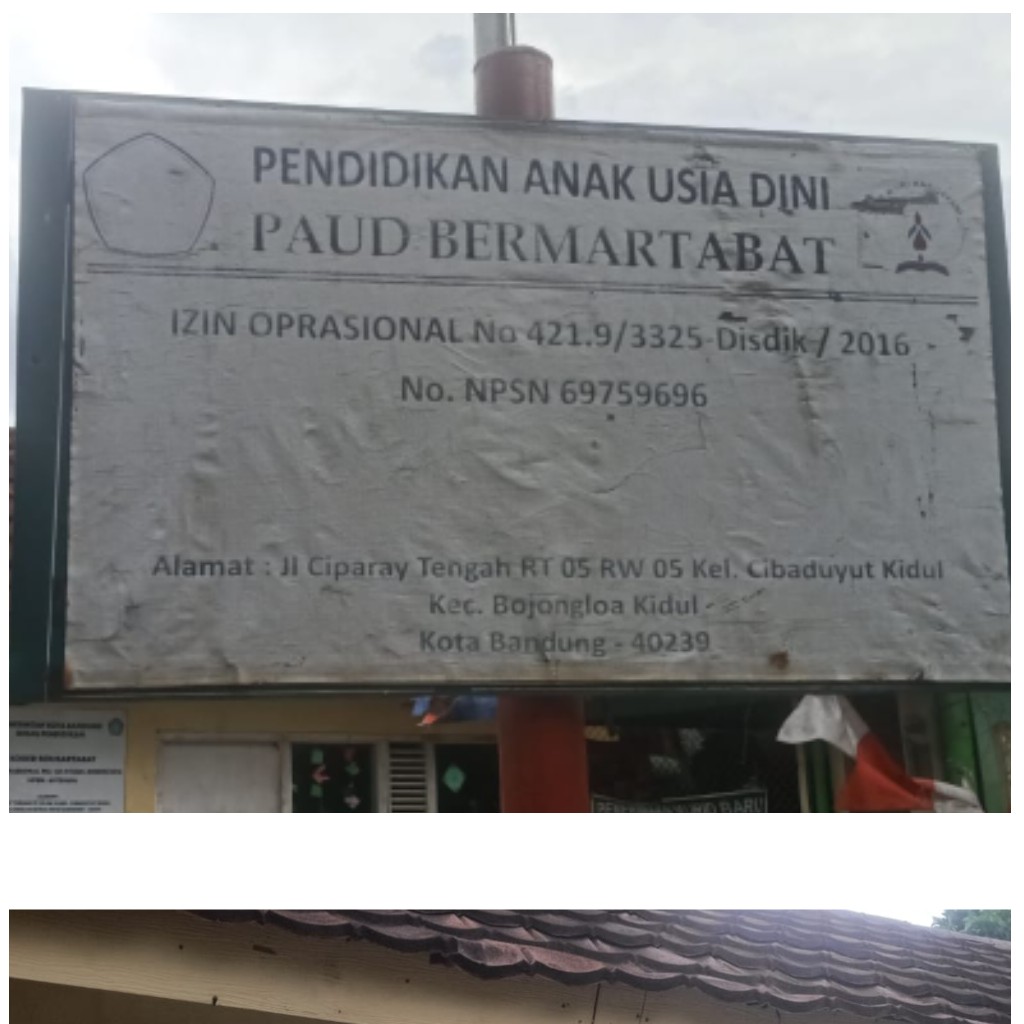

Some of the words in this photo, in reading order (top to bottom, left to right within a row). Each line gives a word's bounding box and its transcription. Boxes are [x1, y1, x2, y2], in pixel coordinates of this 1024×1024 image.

[253, 146, 510, 194] PENDIDIKAN
[521, 157, 635, 203] ANAK
[647, 164, 742, 208] USIA
[750, 173, 830, 211] DINI
[252, 211, 411, 259] PAUD
[431, 217, 835, 276] BERMARTABAT
[171, 309, 236, 337] IZIN
[248, 311, 464, 344] OPRASIONAL
[472, 319, 518, 345] No
[840, 329, 911, 357] 2016
[400, 375, 454, 403] No.
[464, 376, 550, 405] NPSN
[560, 379, 708, 408] 69759696
[151, 554, 255, 578] Alamat
[307, 556, 409, 582] Ciparay
[417, 556, 511, 583] Tengah
[520, 557, 554, 578] RT
[561, 558, 591, 579] 05
[600, 558, 644, 579] RW
[652, 558, 684, 579] 05
[692, 558, 738, 579] Kel.
[746, 558, 876, 584] Cibaduyut
[881, 559, 944, 580] Kidul
[429, 593, 483, 616] Kec.
[492, 594, 625, 620] Bojongloa
[633, 595, 700, 616] Kidul
[419, 631, 479, 653] Kota
[490, 631, 607, 657] Bandung
[631, 631, 710, 654] 40239
